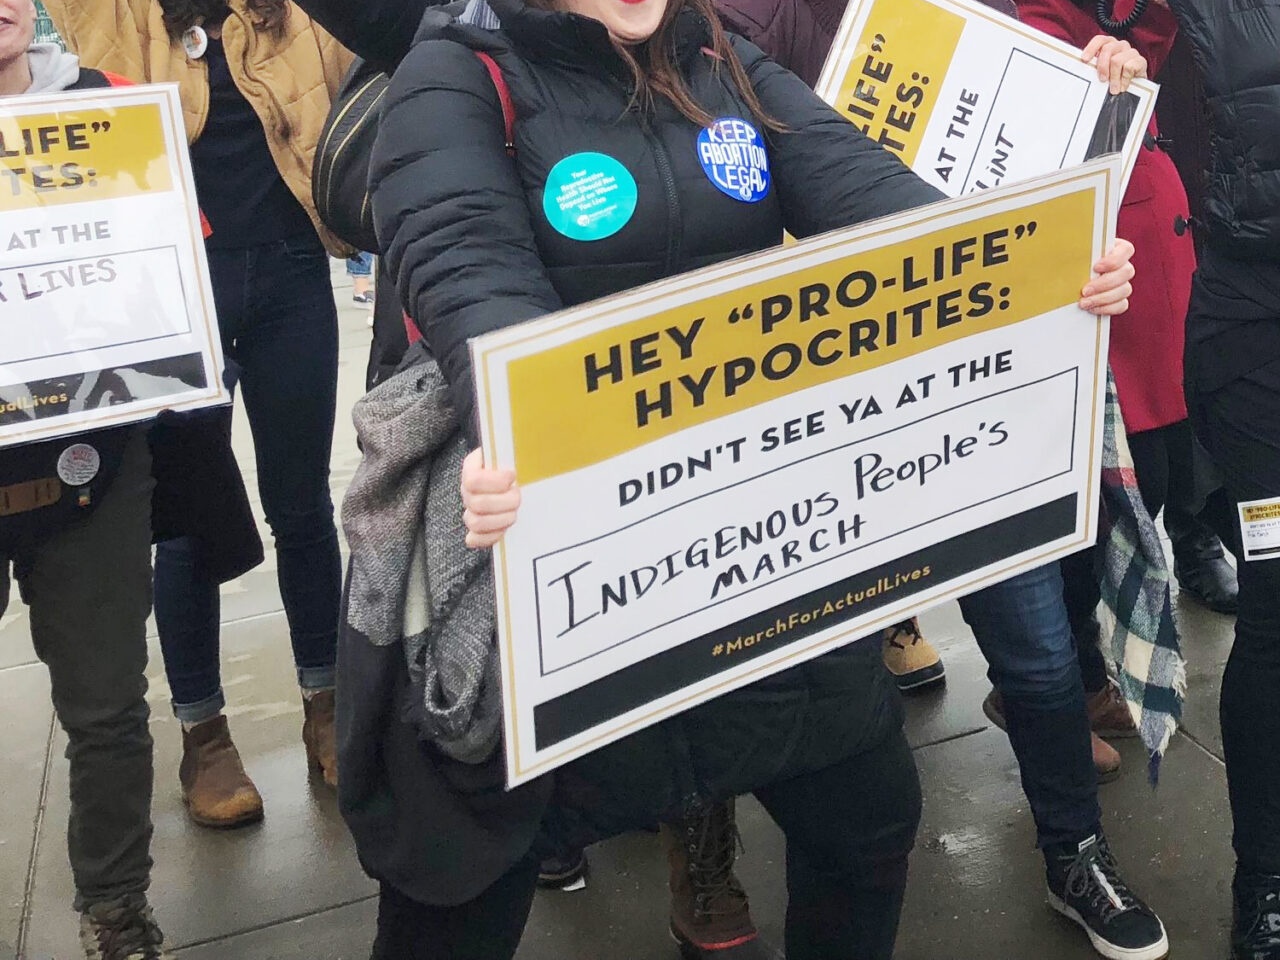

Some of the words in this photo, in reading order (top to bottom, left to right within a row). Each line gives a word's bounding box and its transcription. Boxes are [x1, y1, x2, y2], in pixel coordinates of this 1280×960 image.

[0, 121, 111, 158] LIFE”
[708, 120, 757, 144] KEEP
[945, 88, 980, 140] THE
[700, 142, 767, 172] ABORTION
[712, 164, 766, 193] LEGAL
[934, 148, 957, 184] AT
[970, 122, 1014, 193] LINT
[7, 228, 41, 252] AT
[51, 220, 112, 244] THE
[18, 258, 117, 301] LIVES
[583, 317, 706, 393] HEY
[727, 220, 1038, 334] “PRO-LIFE”
[634, 280, 1011, 429] HYPOCRITES:
[618, 436, 747, 508] DIDN'T
[760, 411, 826, 453] SEE
[838, 396, 884, 424] YA
[895, 373, 936, 407] AT
[947, 349, 1014, 390] THE
[546, 490, 839, 638] INDIGENOUS
[854, 420, 1009, 501] People's
[709, 513, 868, 601] MARCH
[712, 564, 932, 657] #MarchForActualLives
